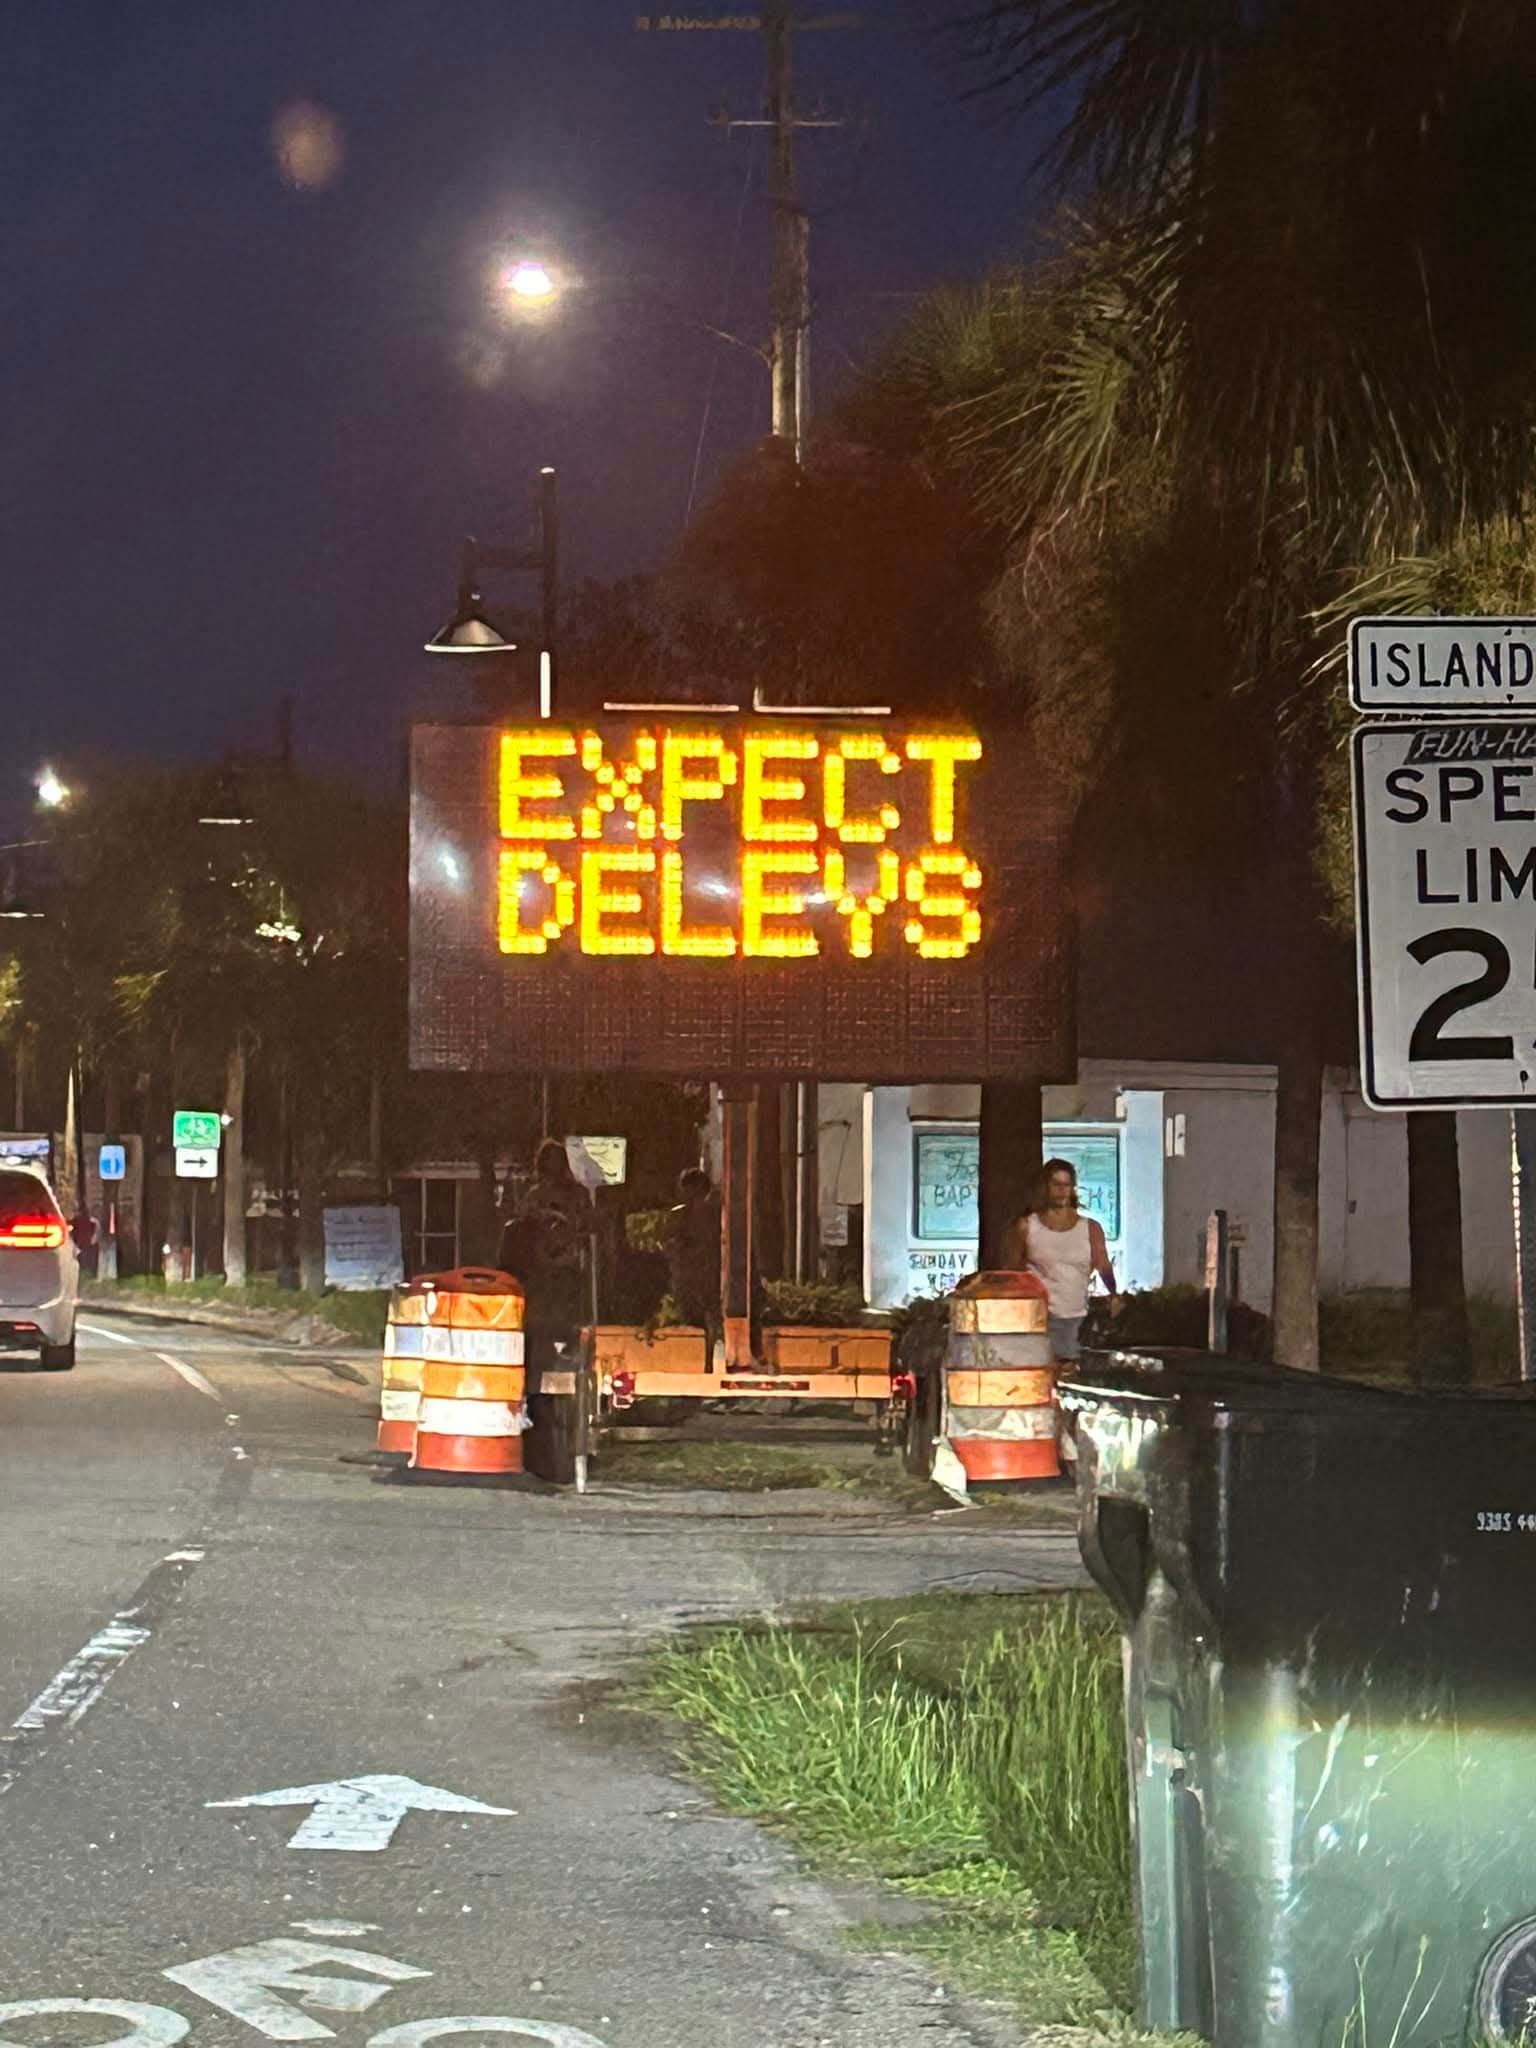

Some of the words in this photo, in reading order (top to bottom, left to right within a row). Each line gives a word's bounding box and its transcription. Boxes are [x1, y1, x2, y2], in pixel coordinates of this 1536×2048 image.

[1369, 641, 1535, 689] ISLAND
[499, 732, 983, 844] EXPECT
[1384, 765, 1536, 824] SPE
[498, 848, 982, 958] DELEYS
[1416, 847, 1536, 904] LIM
[1406, 927, 1536, 1062] 2
